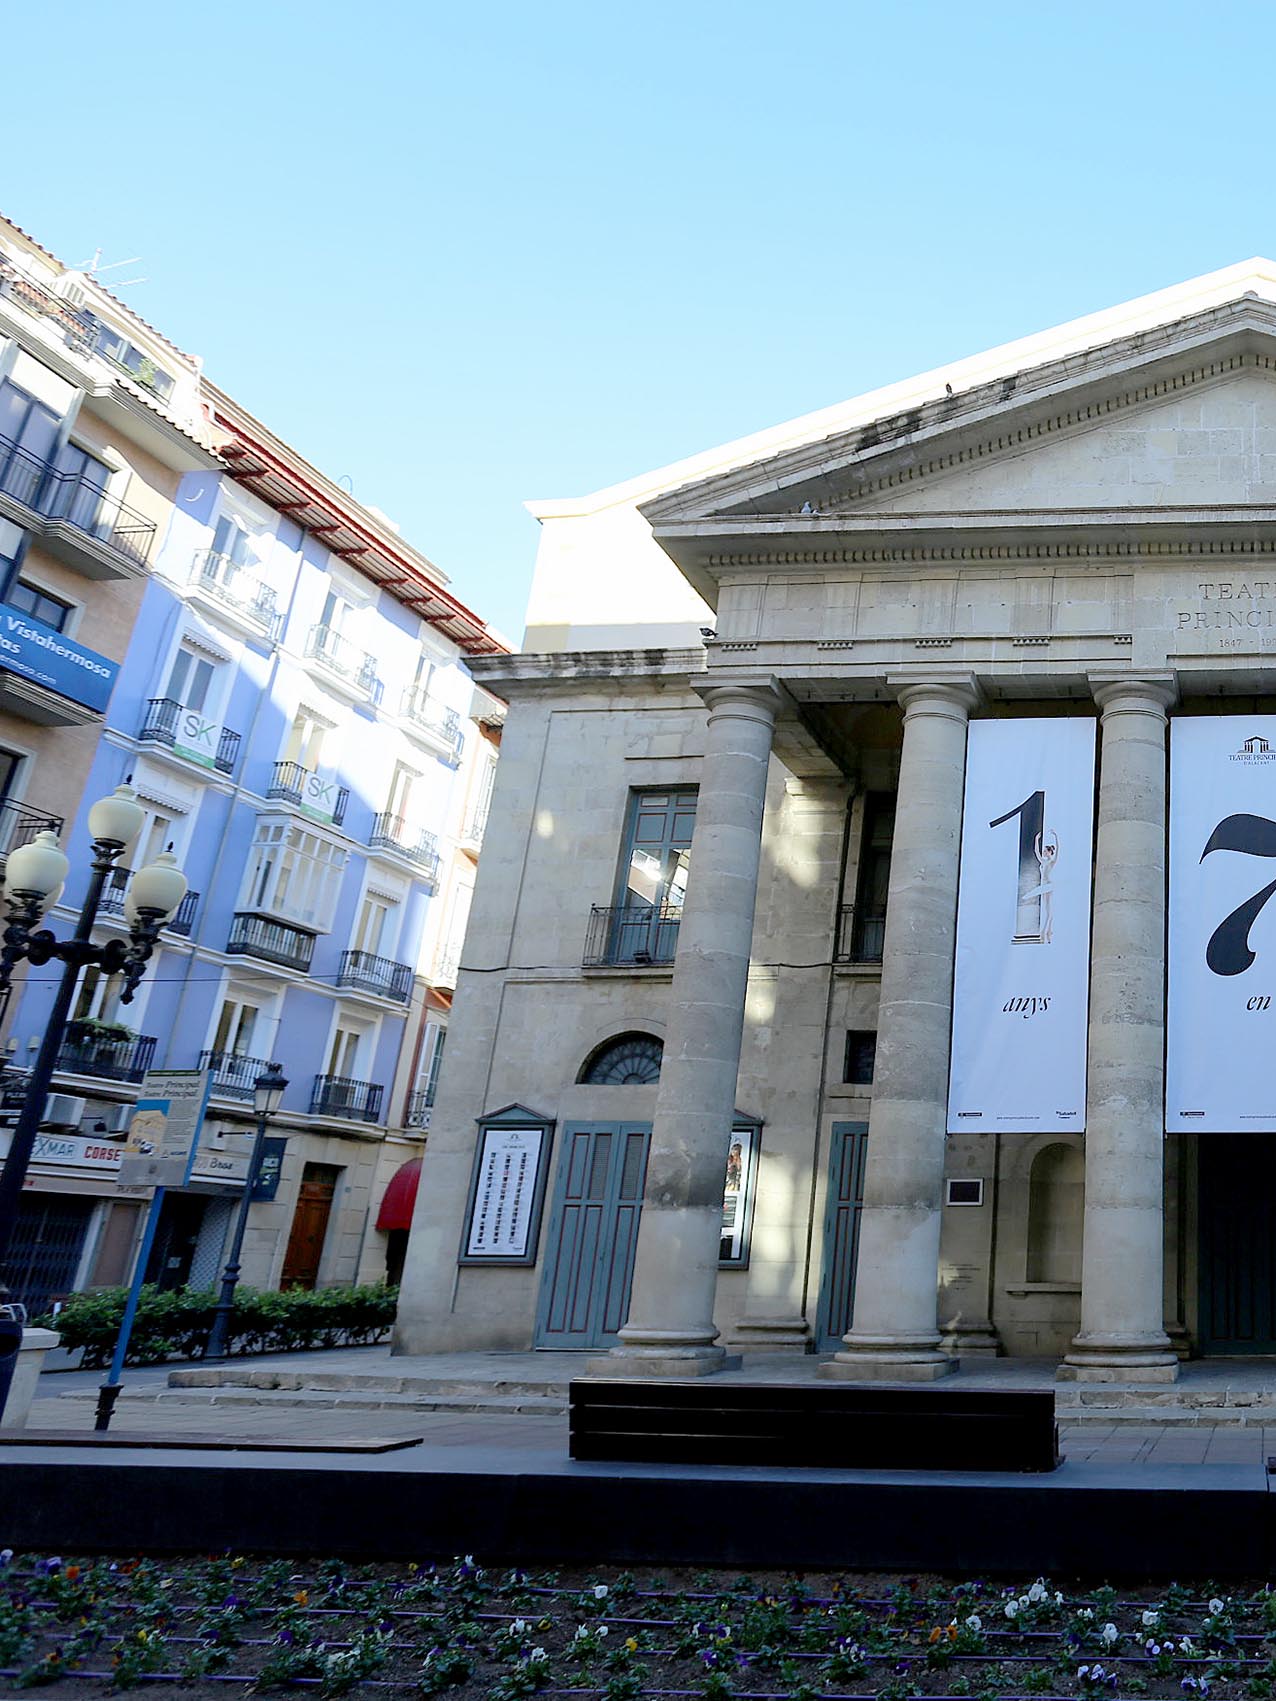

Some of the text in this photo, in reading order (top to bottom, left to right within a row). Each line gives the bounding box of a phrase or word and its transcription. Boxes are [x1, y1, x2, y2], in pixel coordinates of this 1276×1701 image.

[7, 615, 113, 679] Vistahermosa
[183, 714, 218, 746] SK
[1228, 753, 1253, 761] TEATRE
[307, 776, 335, 805] SK
[1002, 991, 1051, 1021] anys
[1246, 992, 1271, 1012] en
